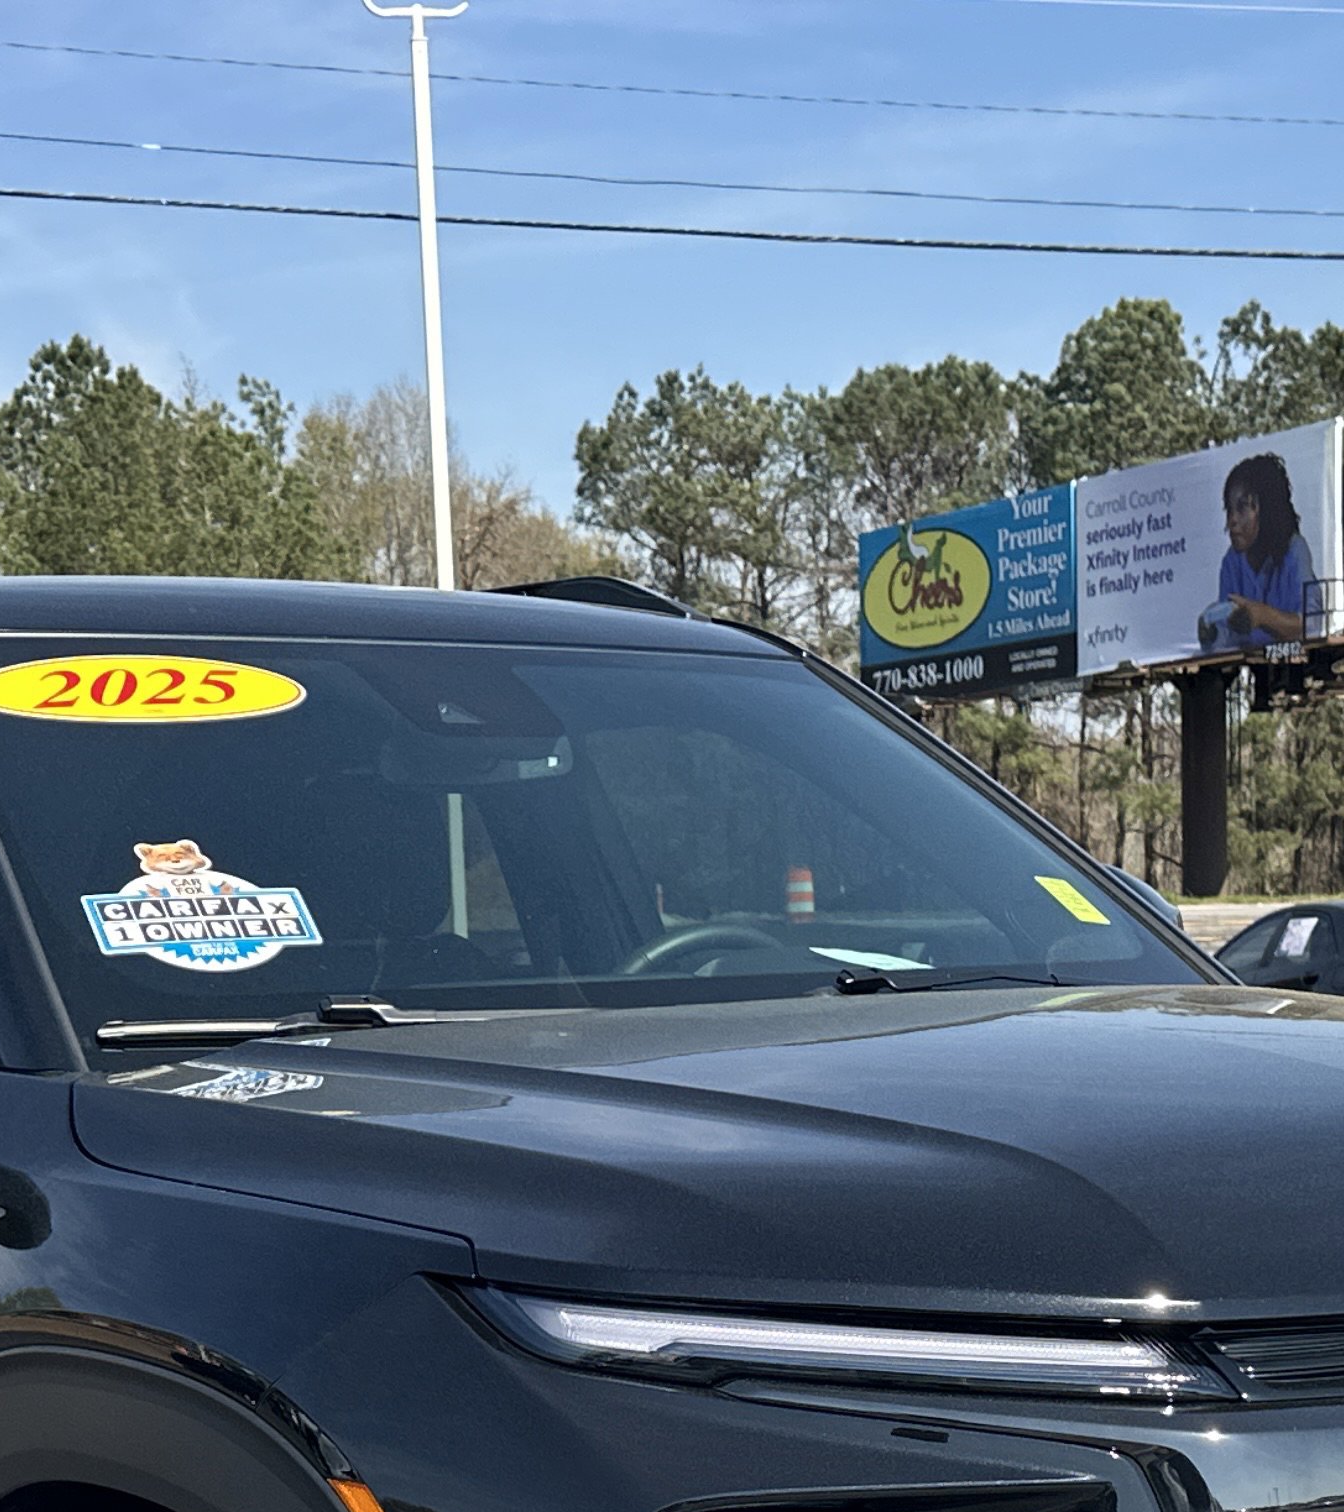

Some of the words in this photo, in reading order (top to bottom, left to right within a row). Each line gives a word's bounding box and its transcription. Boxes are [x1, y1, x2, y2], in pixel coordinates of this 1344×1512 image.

[1010, 494, 1053, 520] Your
[1085, 493, 1127, 519] Carroll
[997, 519, 1067, 552] Premier
[1086, 518, 1144, 546] seriously
[1146, 512, 1172, 534] fast
[998, 551, 1068, 581] Package
[1086, 547, 1130, 572] Xfinity
[1133, 537, 1186, 562] Internet
[1007, 580, 1058, 612] Store!
[1086, 579, 1096, 598] is
[1099, 569, 1141, 595] finally
[1143, 567, 1174, 586] here
[988, 621, 1004, 639] 1.5
[1004, 618, 1034, 637] Miles
[1036, 609, 1071, 632] Ahead
[1086, 623, 1128, 649] xfinity
[33, 668, 238, 709] 2025
[872, 655, 985, 693] 770-838-1000
[171, 877, 201, 888] CAR
[176, 885, 205, 895] FOX
[102, 898, 289, 921] CARFAX
[114, 926, 134, 942] 1
[144, 917, 301, 941] OWNER
